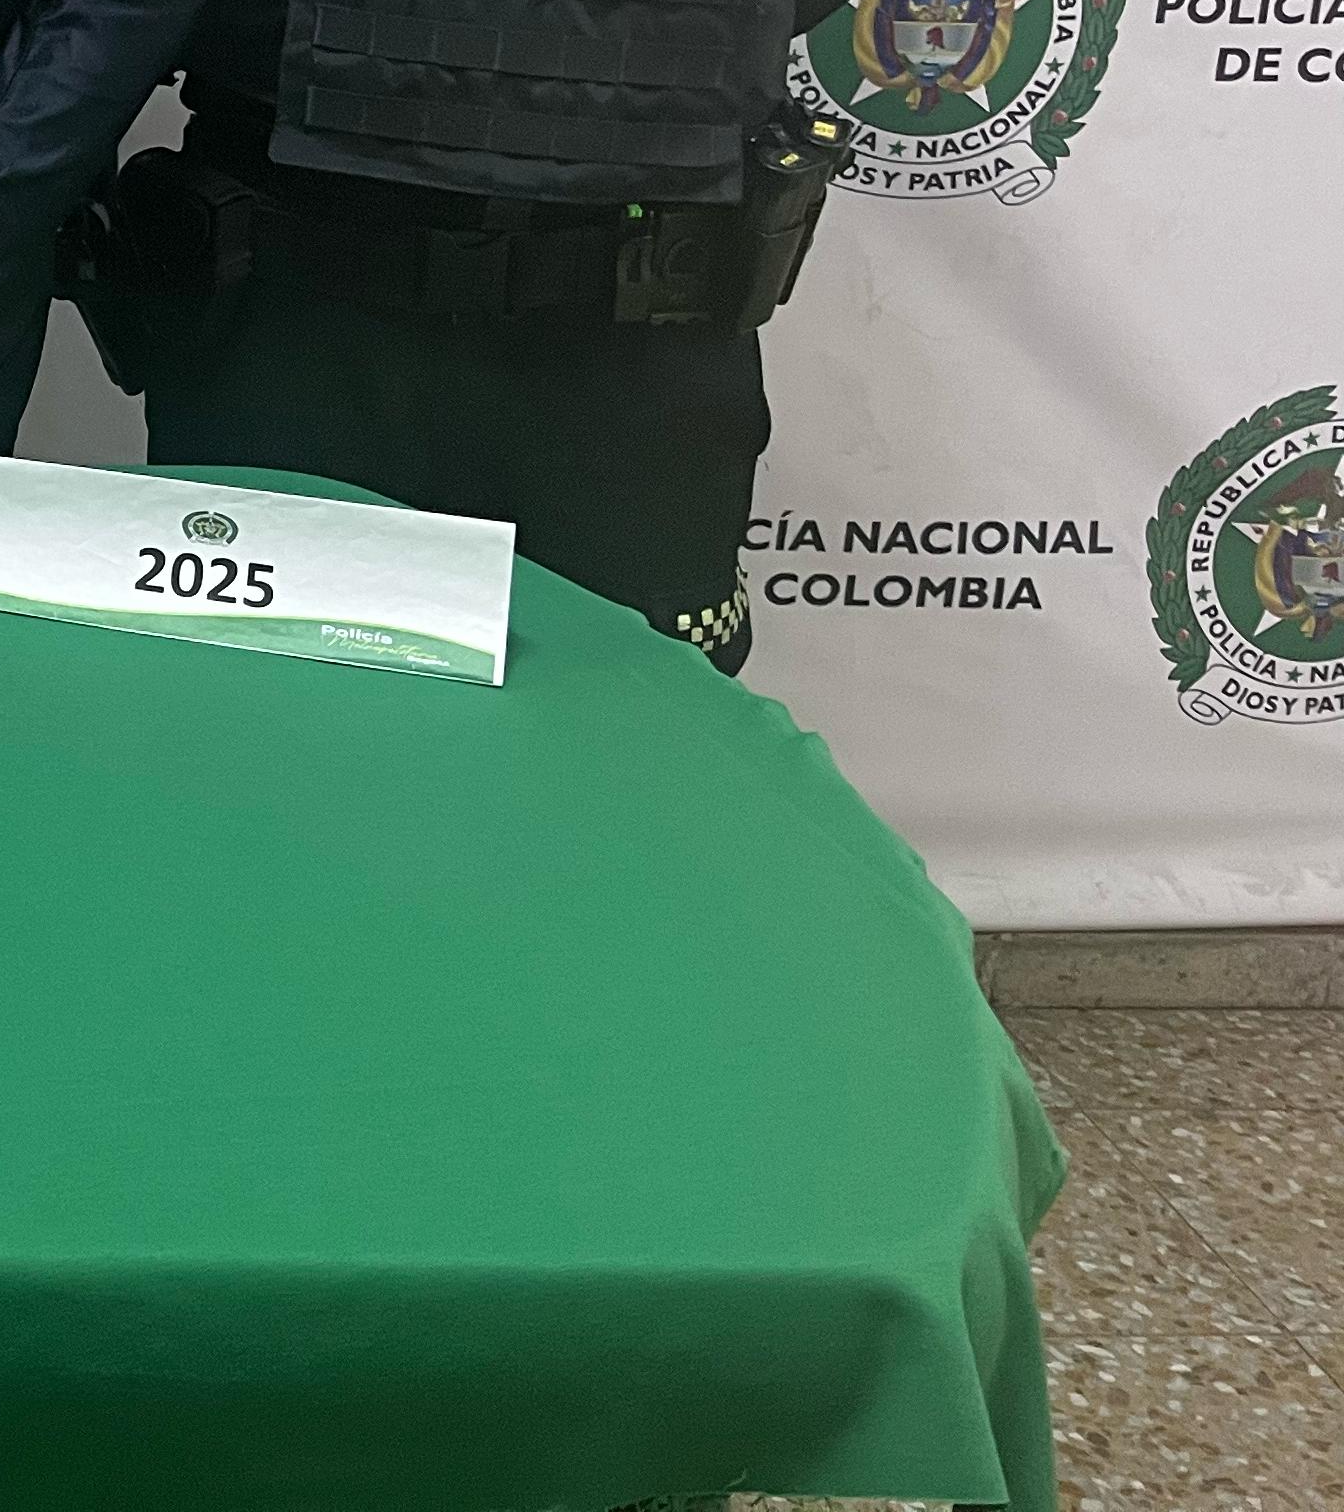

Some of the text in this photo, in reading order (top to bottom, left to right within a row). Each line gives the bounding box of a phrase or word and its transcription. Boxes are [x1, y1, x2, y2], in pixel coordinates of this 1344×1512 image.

[1215, 48, 1282, 81] DE
[916, 77, 1057, 158] NACIONAL
[908, 157, 1015, 191] PATRIA
[843, 521, 1113, 554] NACIONAL
[135, 548, 273, 607] 2025
[764, 573, 1042, 609] COLOMBIA
[321, 624, 393, 645] Policía
